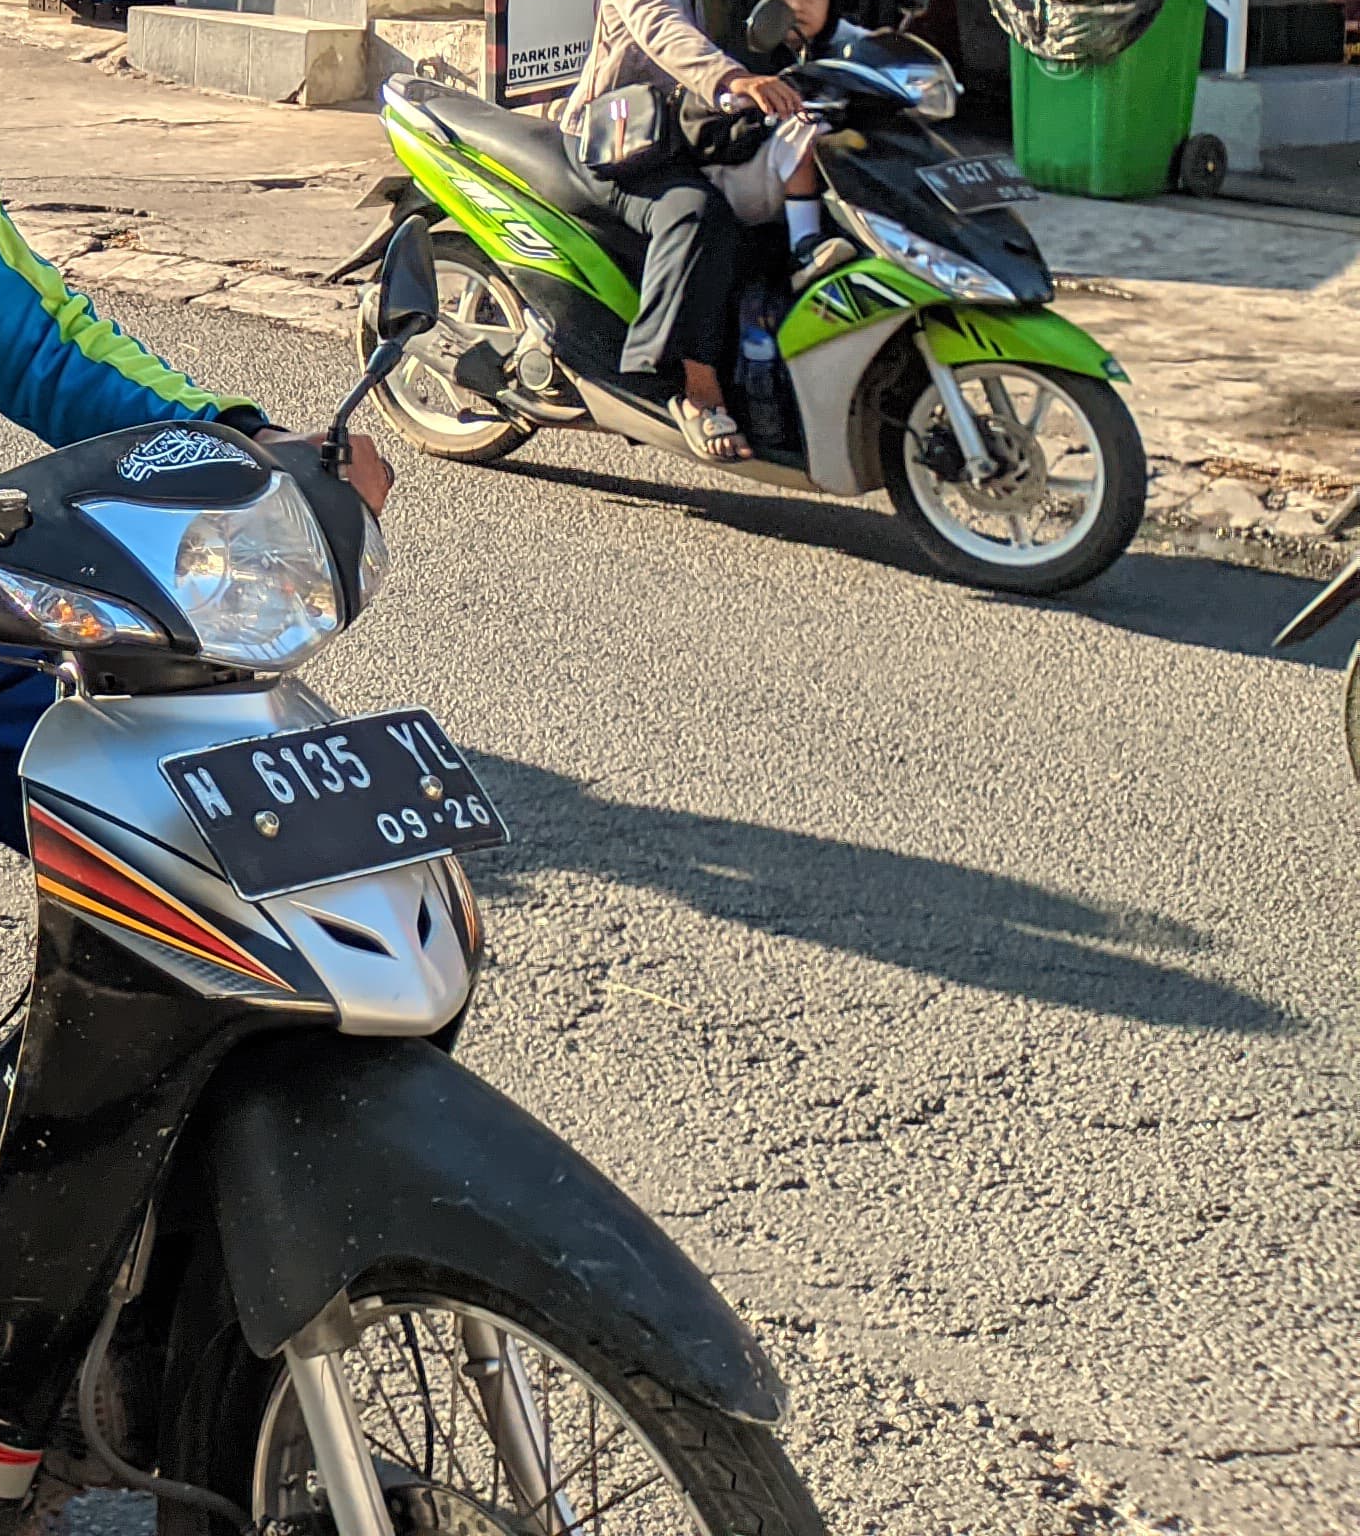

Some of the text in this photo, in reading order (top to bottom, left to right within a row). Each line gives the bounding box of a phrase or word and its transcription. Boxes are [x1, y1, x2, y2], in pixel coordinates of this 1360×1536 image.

[511, 40, 591, 65] PARKIR KHU
[509, 56, 586, 80] BUTIK SAVI
[184, 721, 461, 819] N 6135 YL
